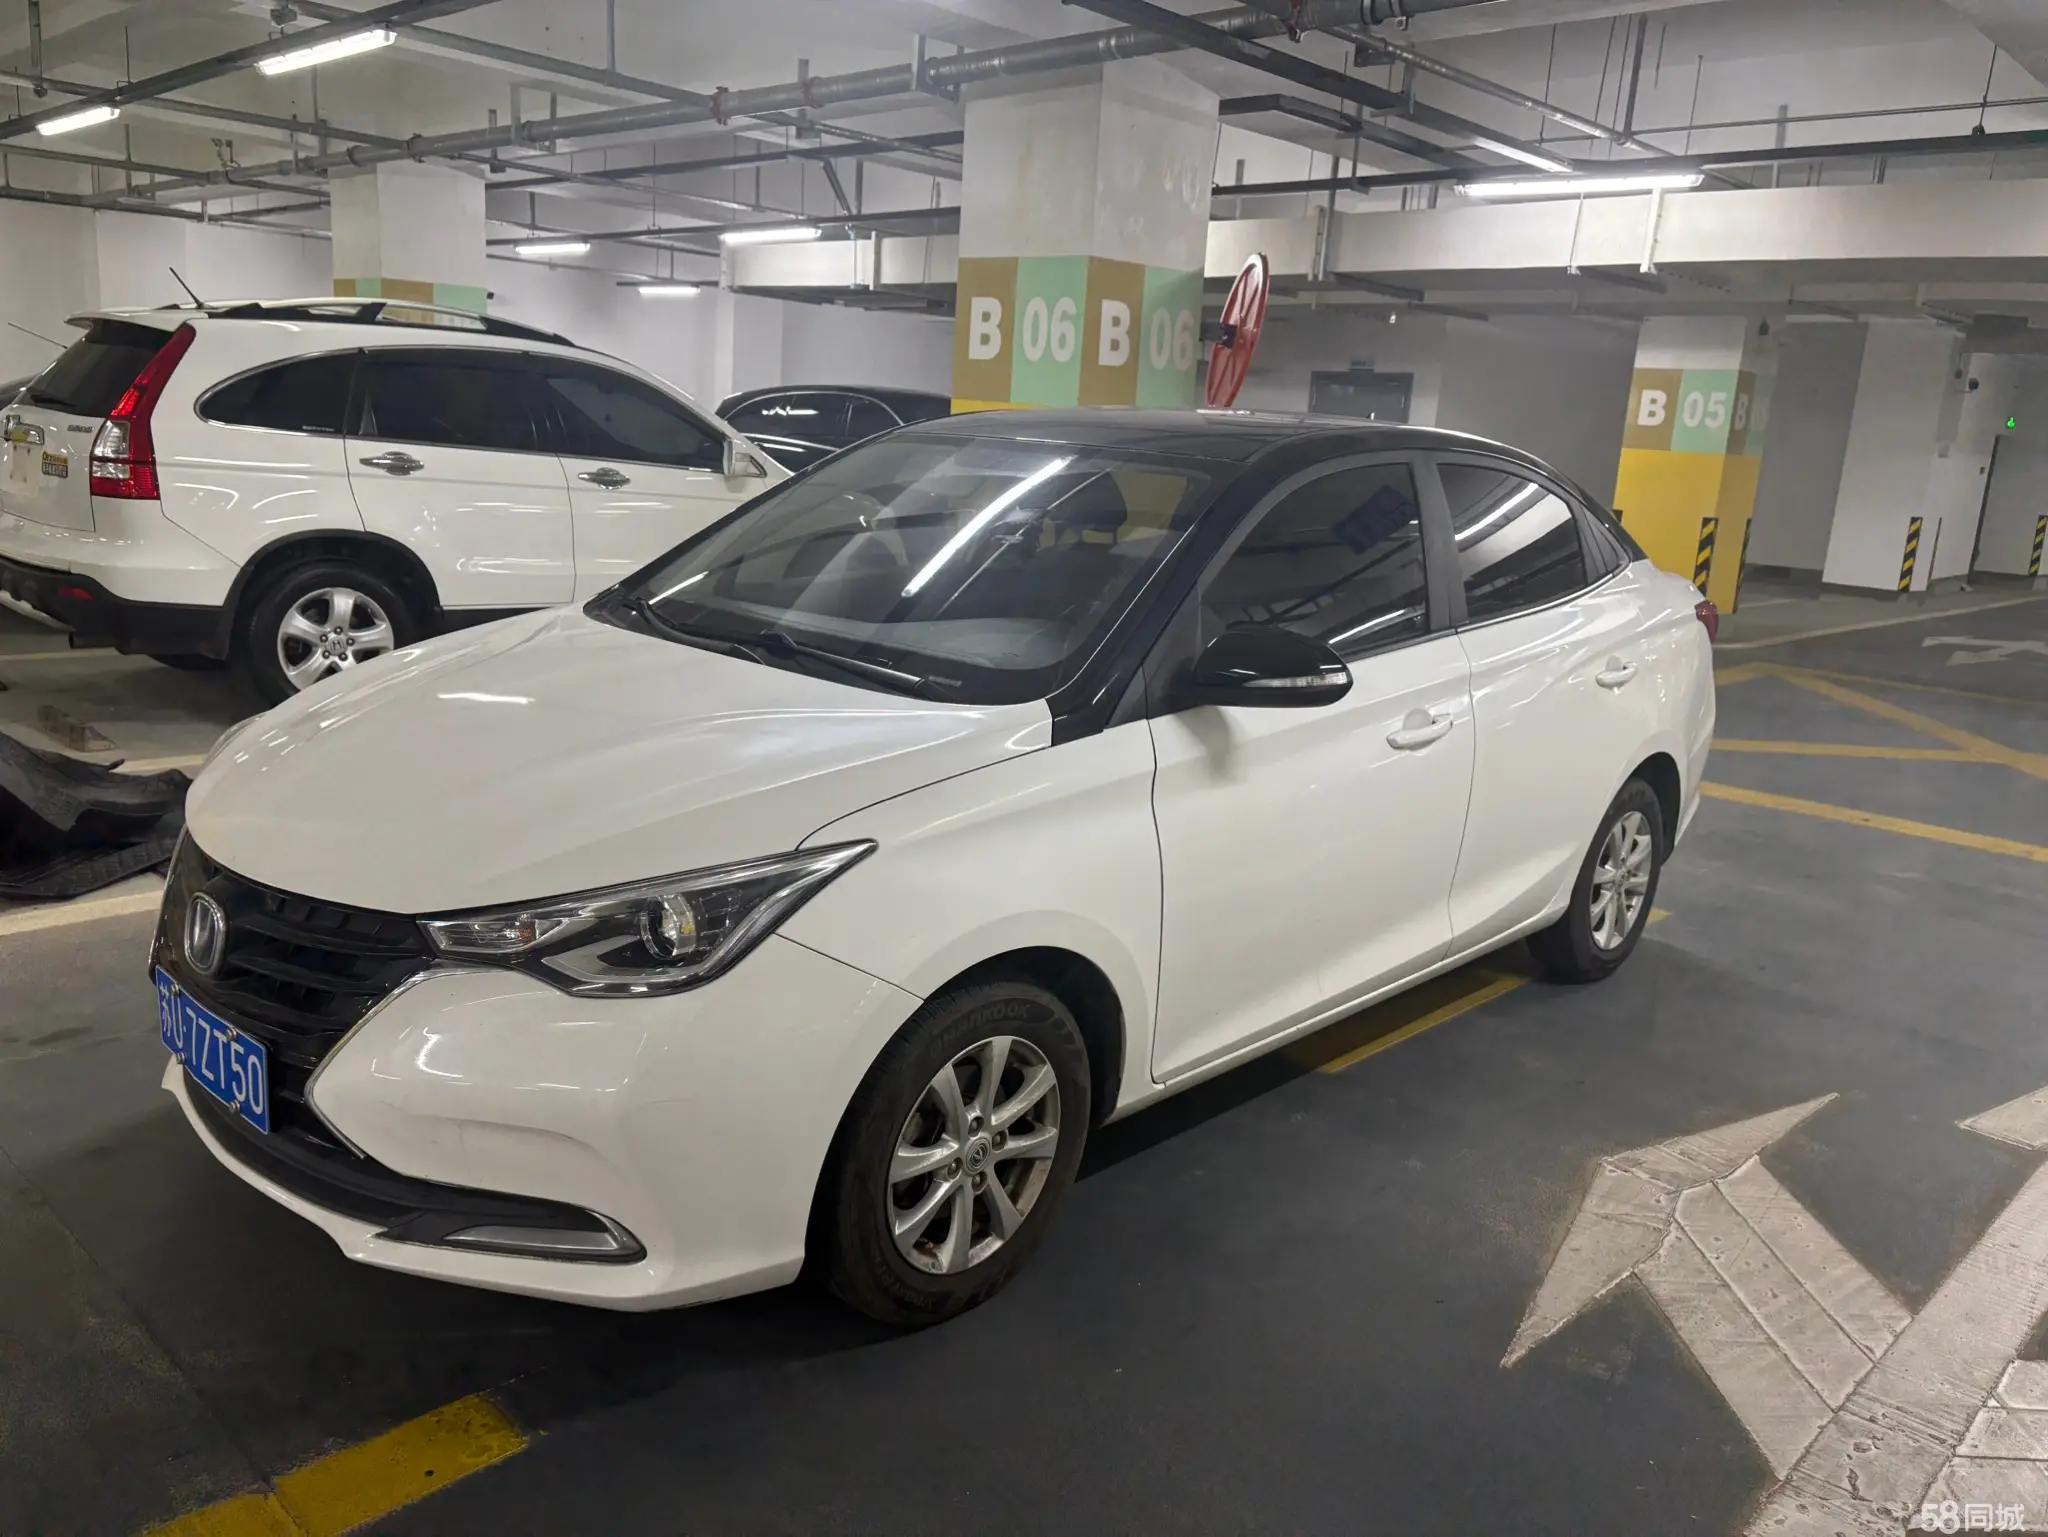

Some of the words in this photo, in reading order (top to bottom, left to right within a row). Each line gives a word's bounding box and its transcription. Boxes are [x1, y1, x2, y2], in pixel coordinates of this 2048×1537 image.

[968, 297, 1003, 360] B
[1022, 297, 1078, 362] 06
[1098, 299, 1132, 367] B
[1150, 307, 1195, 371] 06
[1637, 389, 1667, 426] B
[1682, 391, 1727, 428] 05
